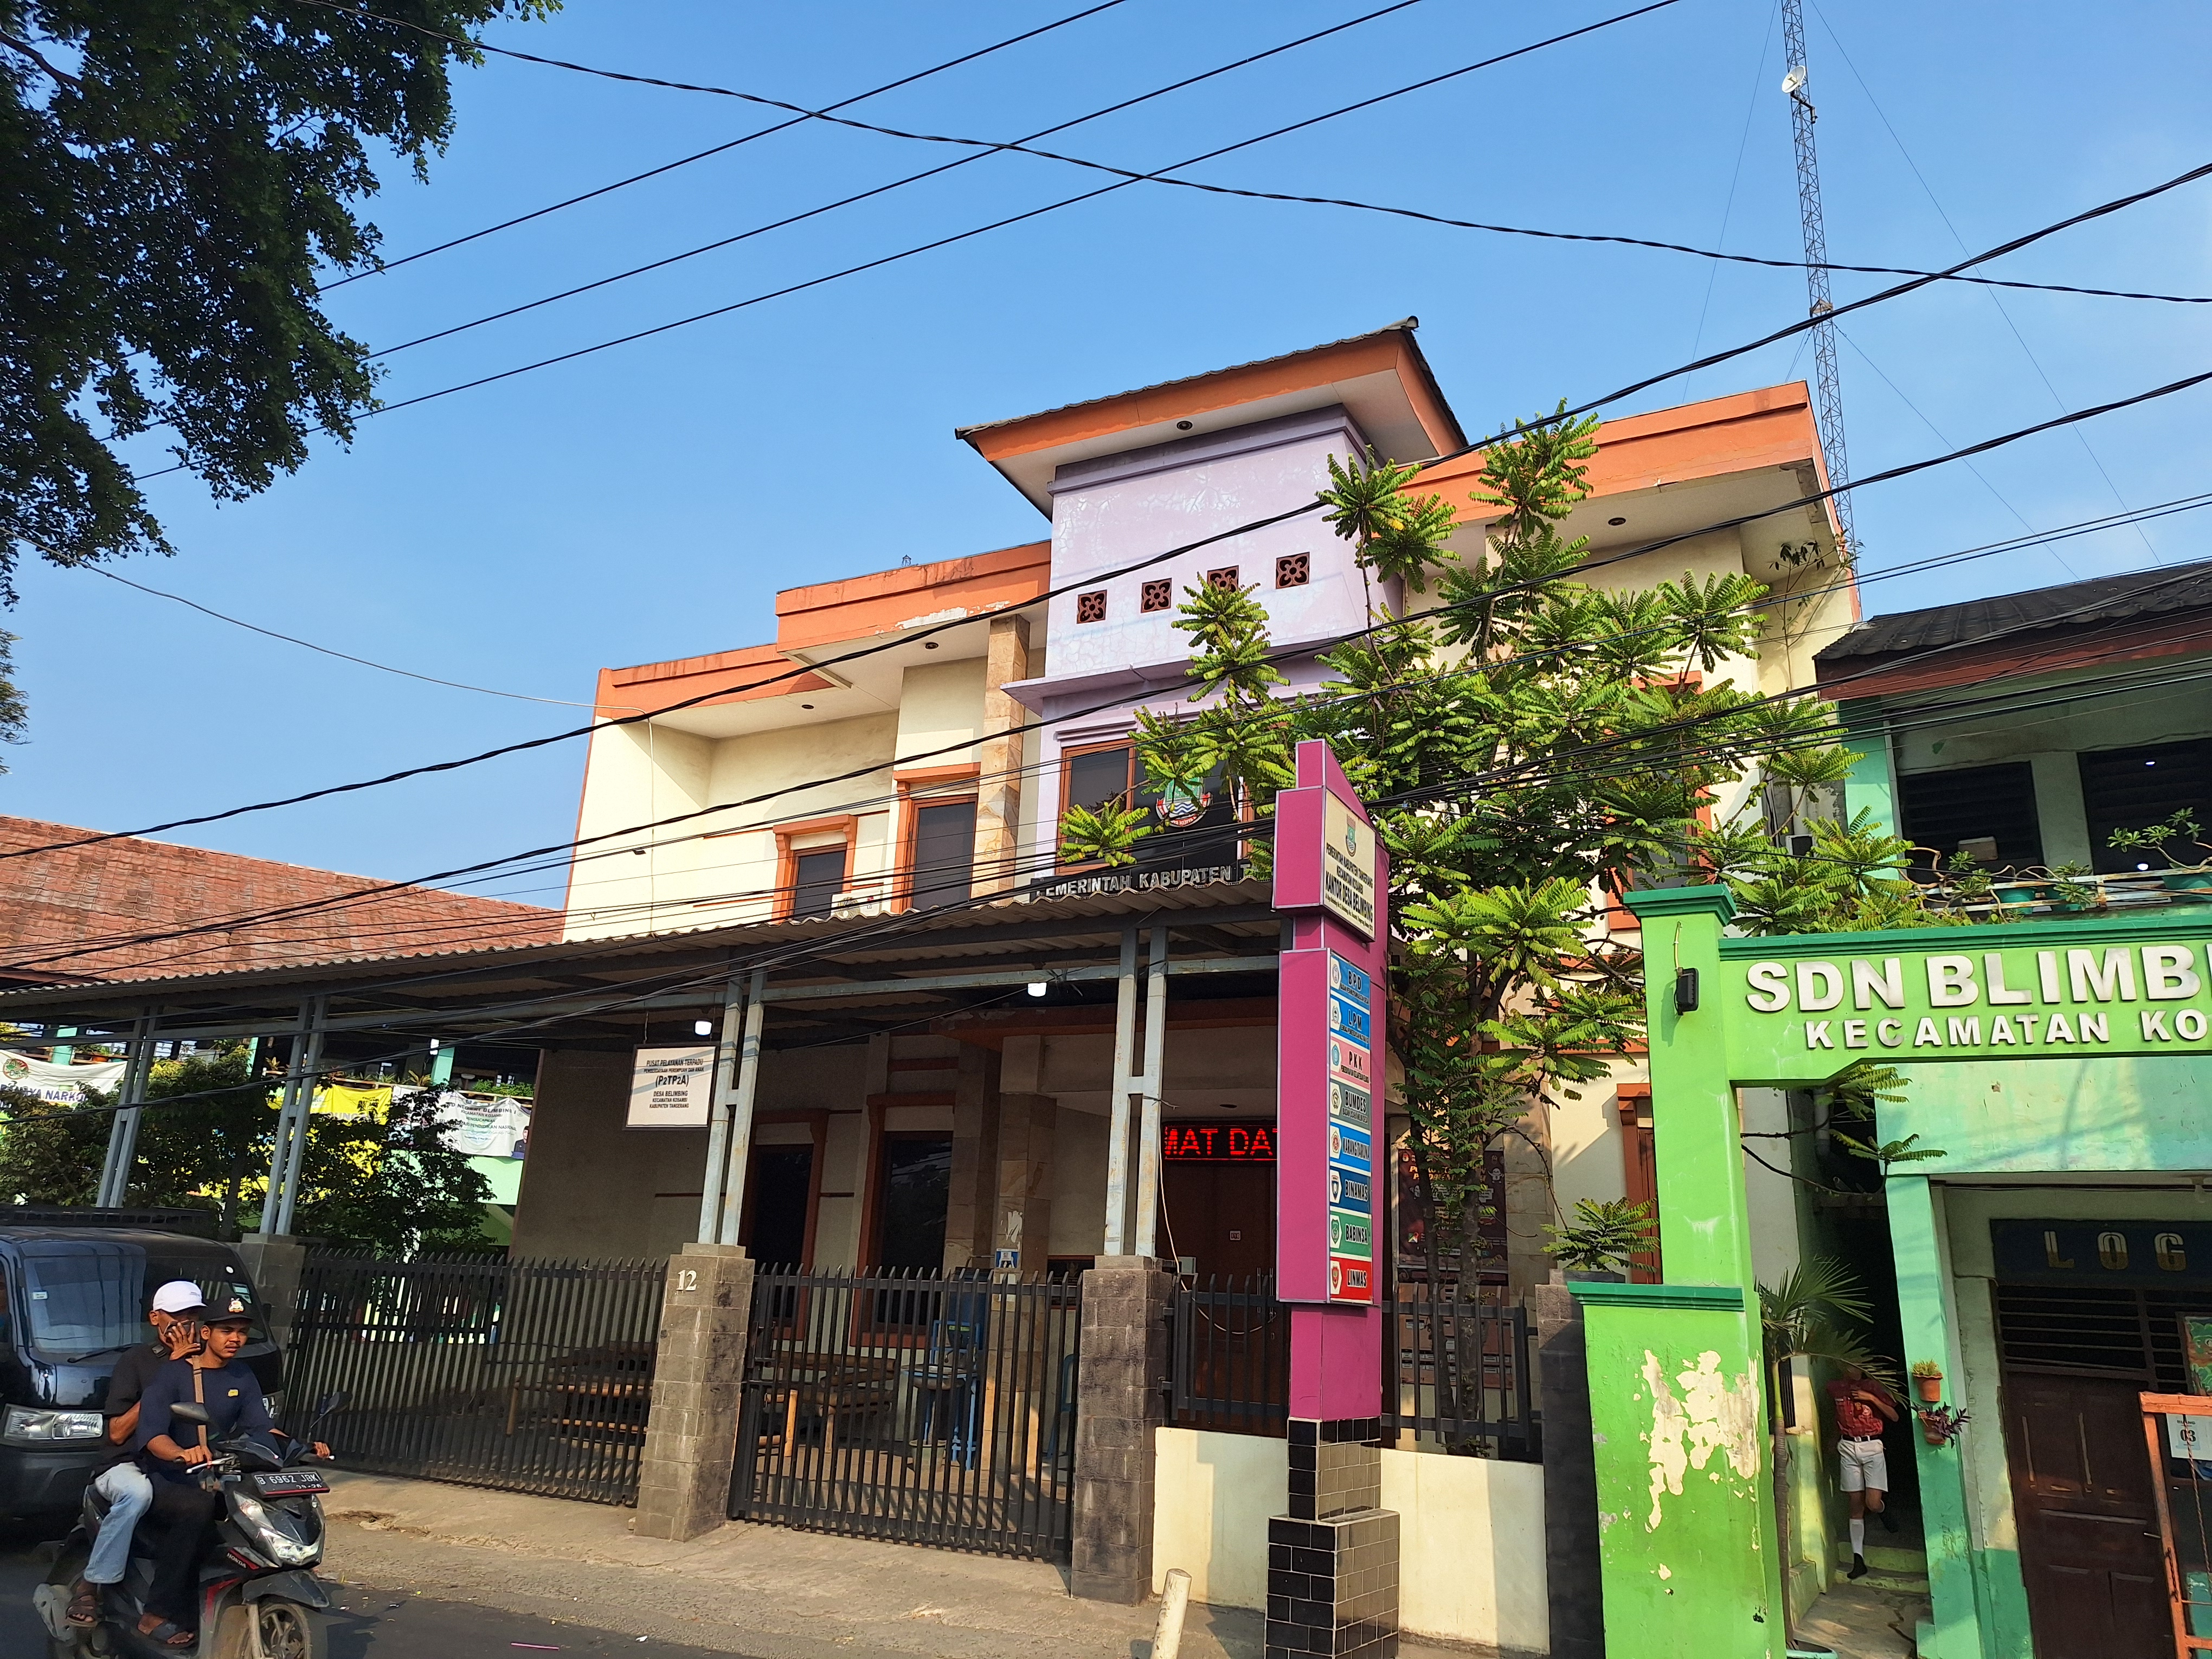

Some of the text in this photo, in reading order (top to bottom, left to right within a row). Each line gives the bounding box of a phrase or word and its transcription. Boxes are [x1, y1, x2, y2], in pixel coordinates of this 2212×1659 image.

[1139, 865, 1231, 889] KABUPATEN
[1326, 870, 1342, 901] KANTOR
[1342, 883, 1353, 909] DESA
[1353, 891, 1373, 923] BELIMBING
[1348, 970, 1361, 991] BPD
[1746, 957, 1905, 1013] SDN
[1348, 1009, 1362, 1031] LPM
[1806, 1012, 2110, 1049] KECAMATAN
[1349, 1050, 1362, 1071] PKK
[655, 1075, 689, 1088] (P2TP2A)
[1345, 1090, 1366, 1113] BUMDES
[1230, 1128, 1277, 1155] DA
[1343, 1136, 1369, 1161] KARANG TARUNA
[1345, 1180, 1368, 1201] BINAMAS
[1345, 1224, 1368, 1243] BABINSA
[676, 1269, 697, 1290] 12
[1347, 1269, 1367, 1288] LINMAS
[2180, 1429, 2196, 1442] 03
[256, 1474, 318, 1485] B 6962 JBK
[227, 1552, 247, 1568] HONDA
